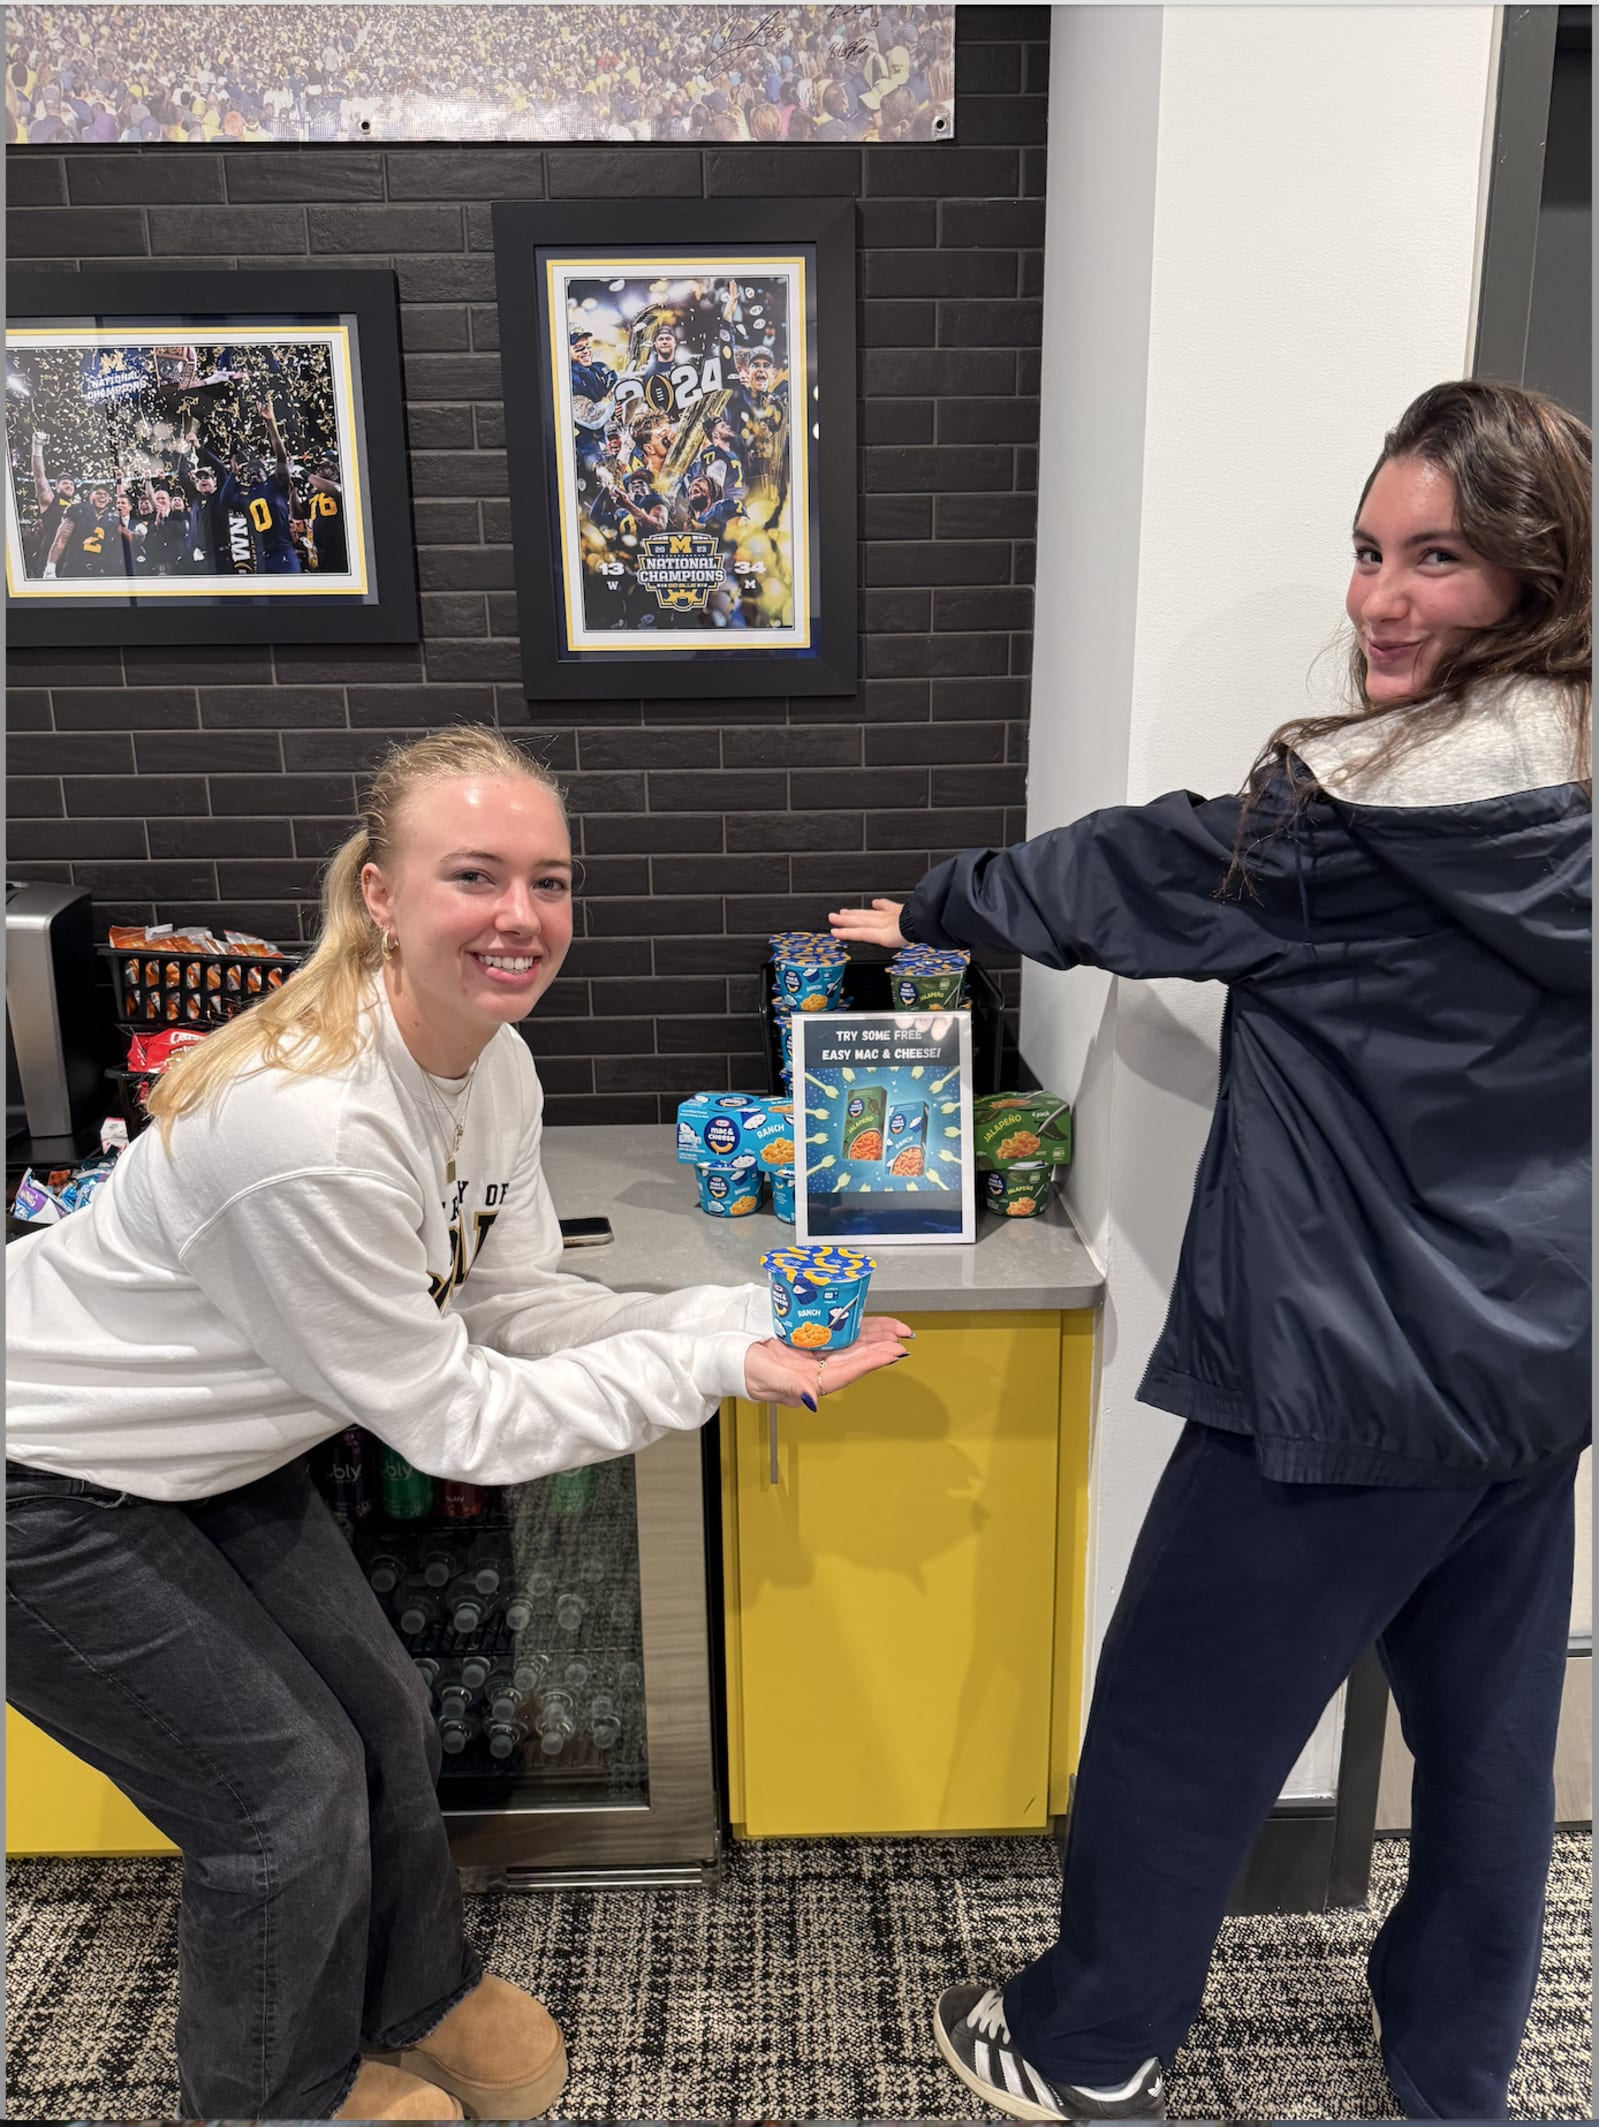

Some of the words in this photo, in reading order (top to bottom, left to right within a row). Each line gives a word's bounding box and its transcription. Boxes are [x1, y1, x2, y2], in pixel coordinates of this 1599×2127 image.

[249, 497, 273, 533] 0
[82, 526, 105, 554] 2
[669, 535, 692, 554] M
[600, 562, 625, 576] 13
[646, 558, 717, 570] NATIONAL
[734, 561, 766, 575] 34
[640, 570, 724, 582] CHAMPIONS
[607, 581, 619, 591] W
[744, 580, 756, 589] M
[836, 1030, 858, 1042] TRY
[861, 1030, 891, 1041] SOME
[894, 1029, 923, 1040] FREE
[822, 1049, 851, 1061] EASY
[854, 1049, 880, 1060] MAC
[882, 1048, 891, 1060] &
[894, 1048, 941, 1060] CHEESE!
[757, 1123, 785, 1140] RANCH
[983, 1113, 1022, 1142] JALAPEÑO
[797, 1309, 822, 1318] RANCH
